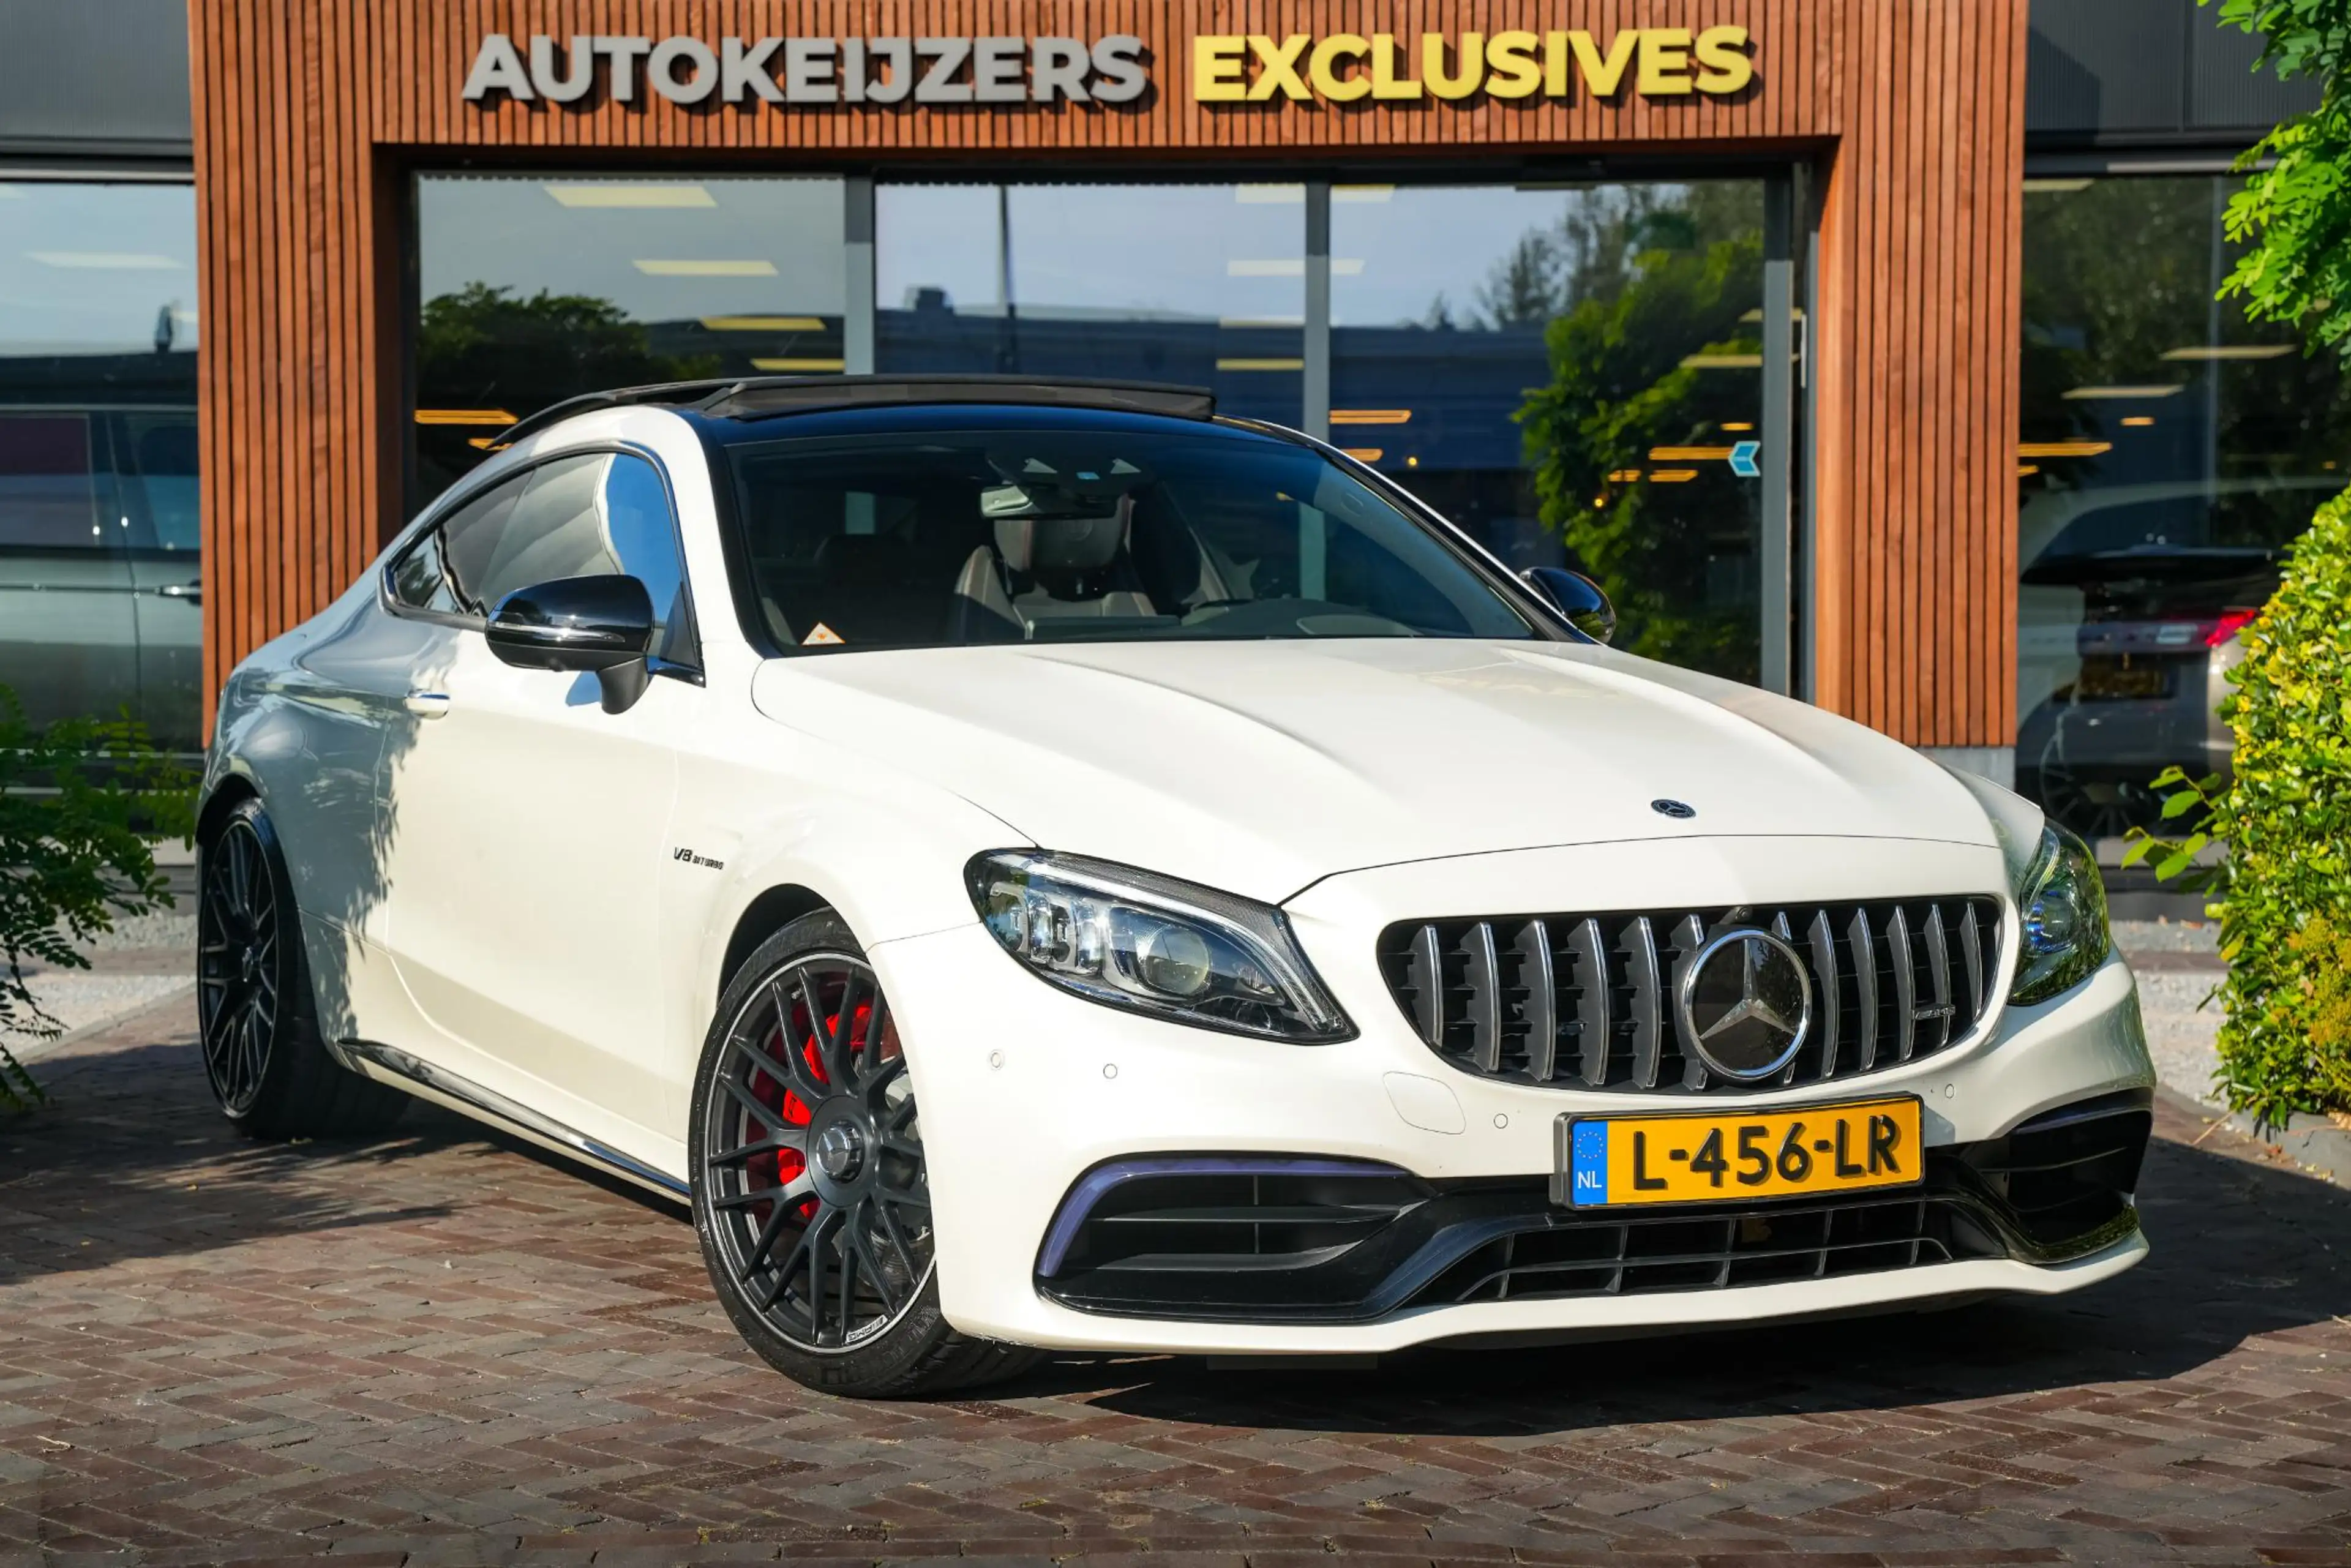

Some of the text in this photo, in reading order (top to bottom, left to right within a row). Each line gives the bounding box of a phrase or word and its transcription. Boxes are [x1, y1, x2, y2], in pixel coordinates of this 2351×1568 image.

[462, 25, 1753, 104] AUTOKEIJZERS EXCLUSIVES
[674, 847, 692, 862] V8
[1633, 1114, 1901, 1190] L-456-LR
[1577, 1171, 1602, 1188] NL
